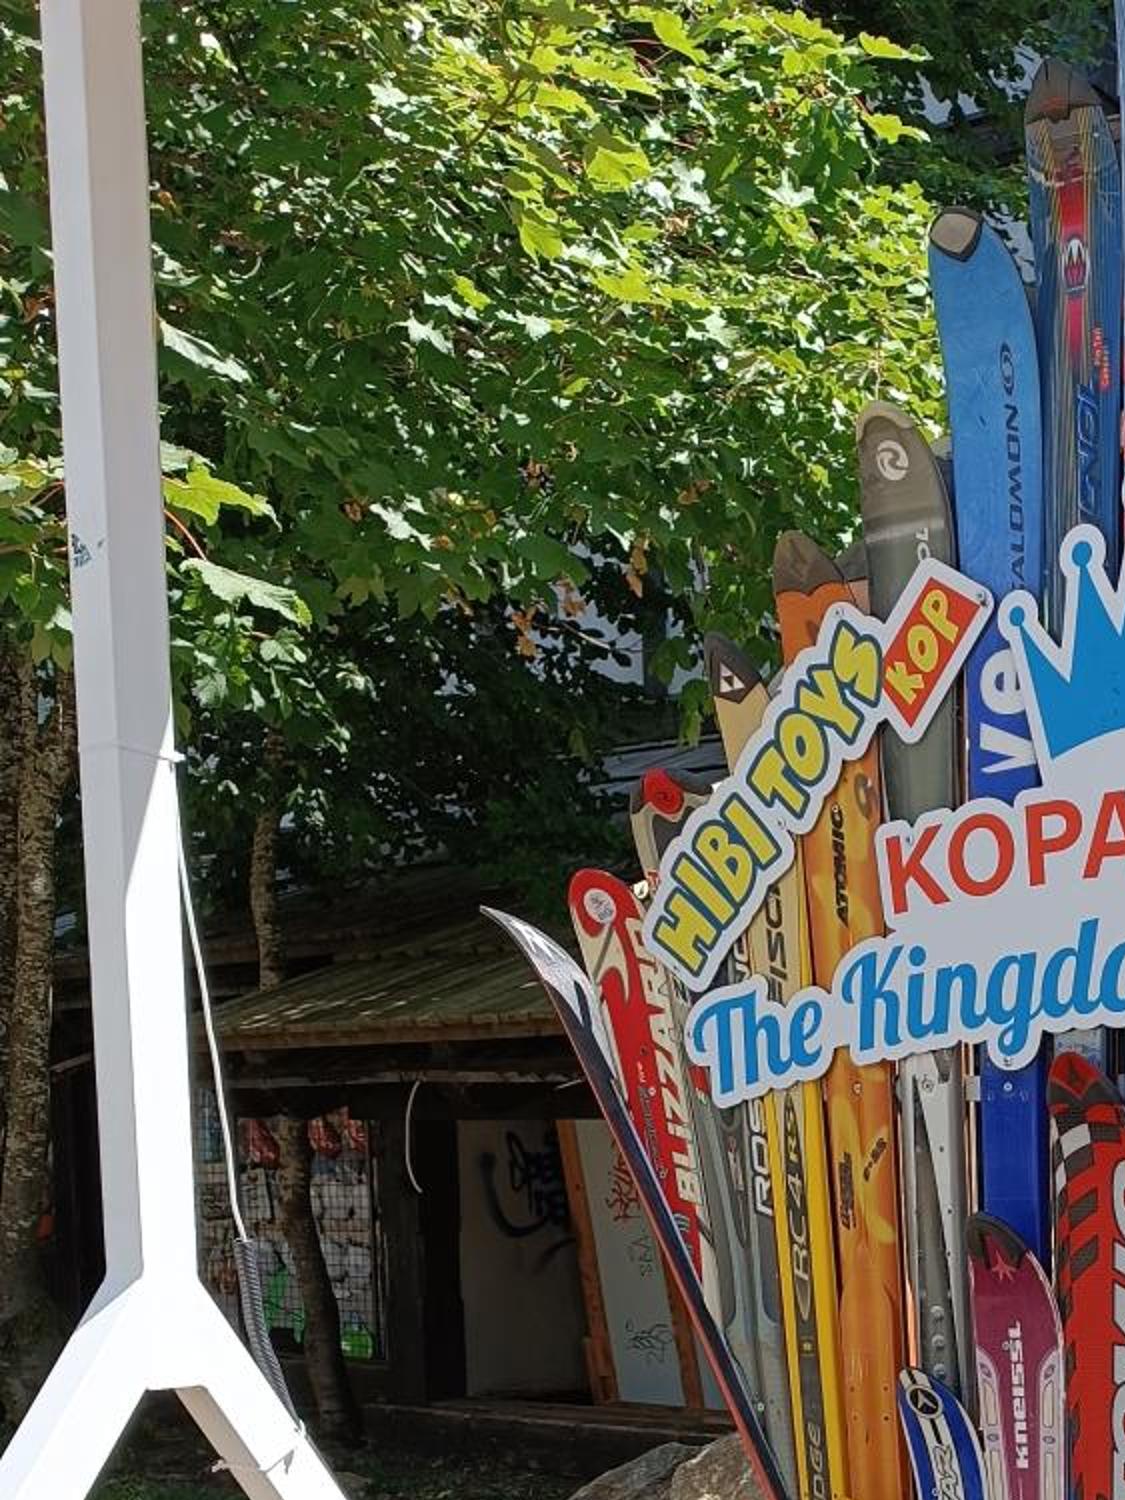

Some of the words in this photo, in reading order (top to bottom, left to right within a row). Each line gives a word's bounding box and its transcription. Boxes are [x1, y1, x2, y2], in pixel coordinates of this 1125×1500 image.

[1003, 404, 1026, 590] ALOMON
[885, 588, 960, 705] KOP
[654, 797, 779, 972] HIBI
[749, 621, 882, 817] TOYS
[830, 806, 850, 930] ATOMIC
[693, 991, 823, 1096] The
